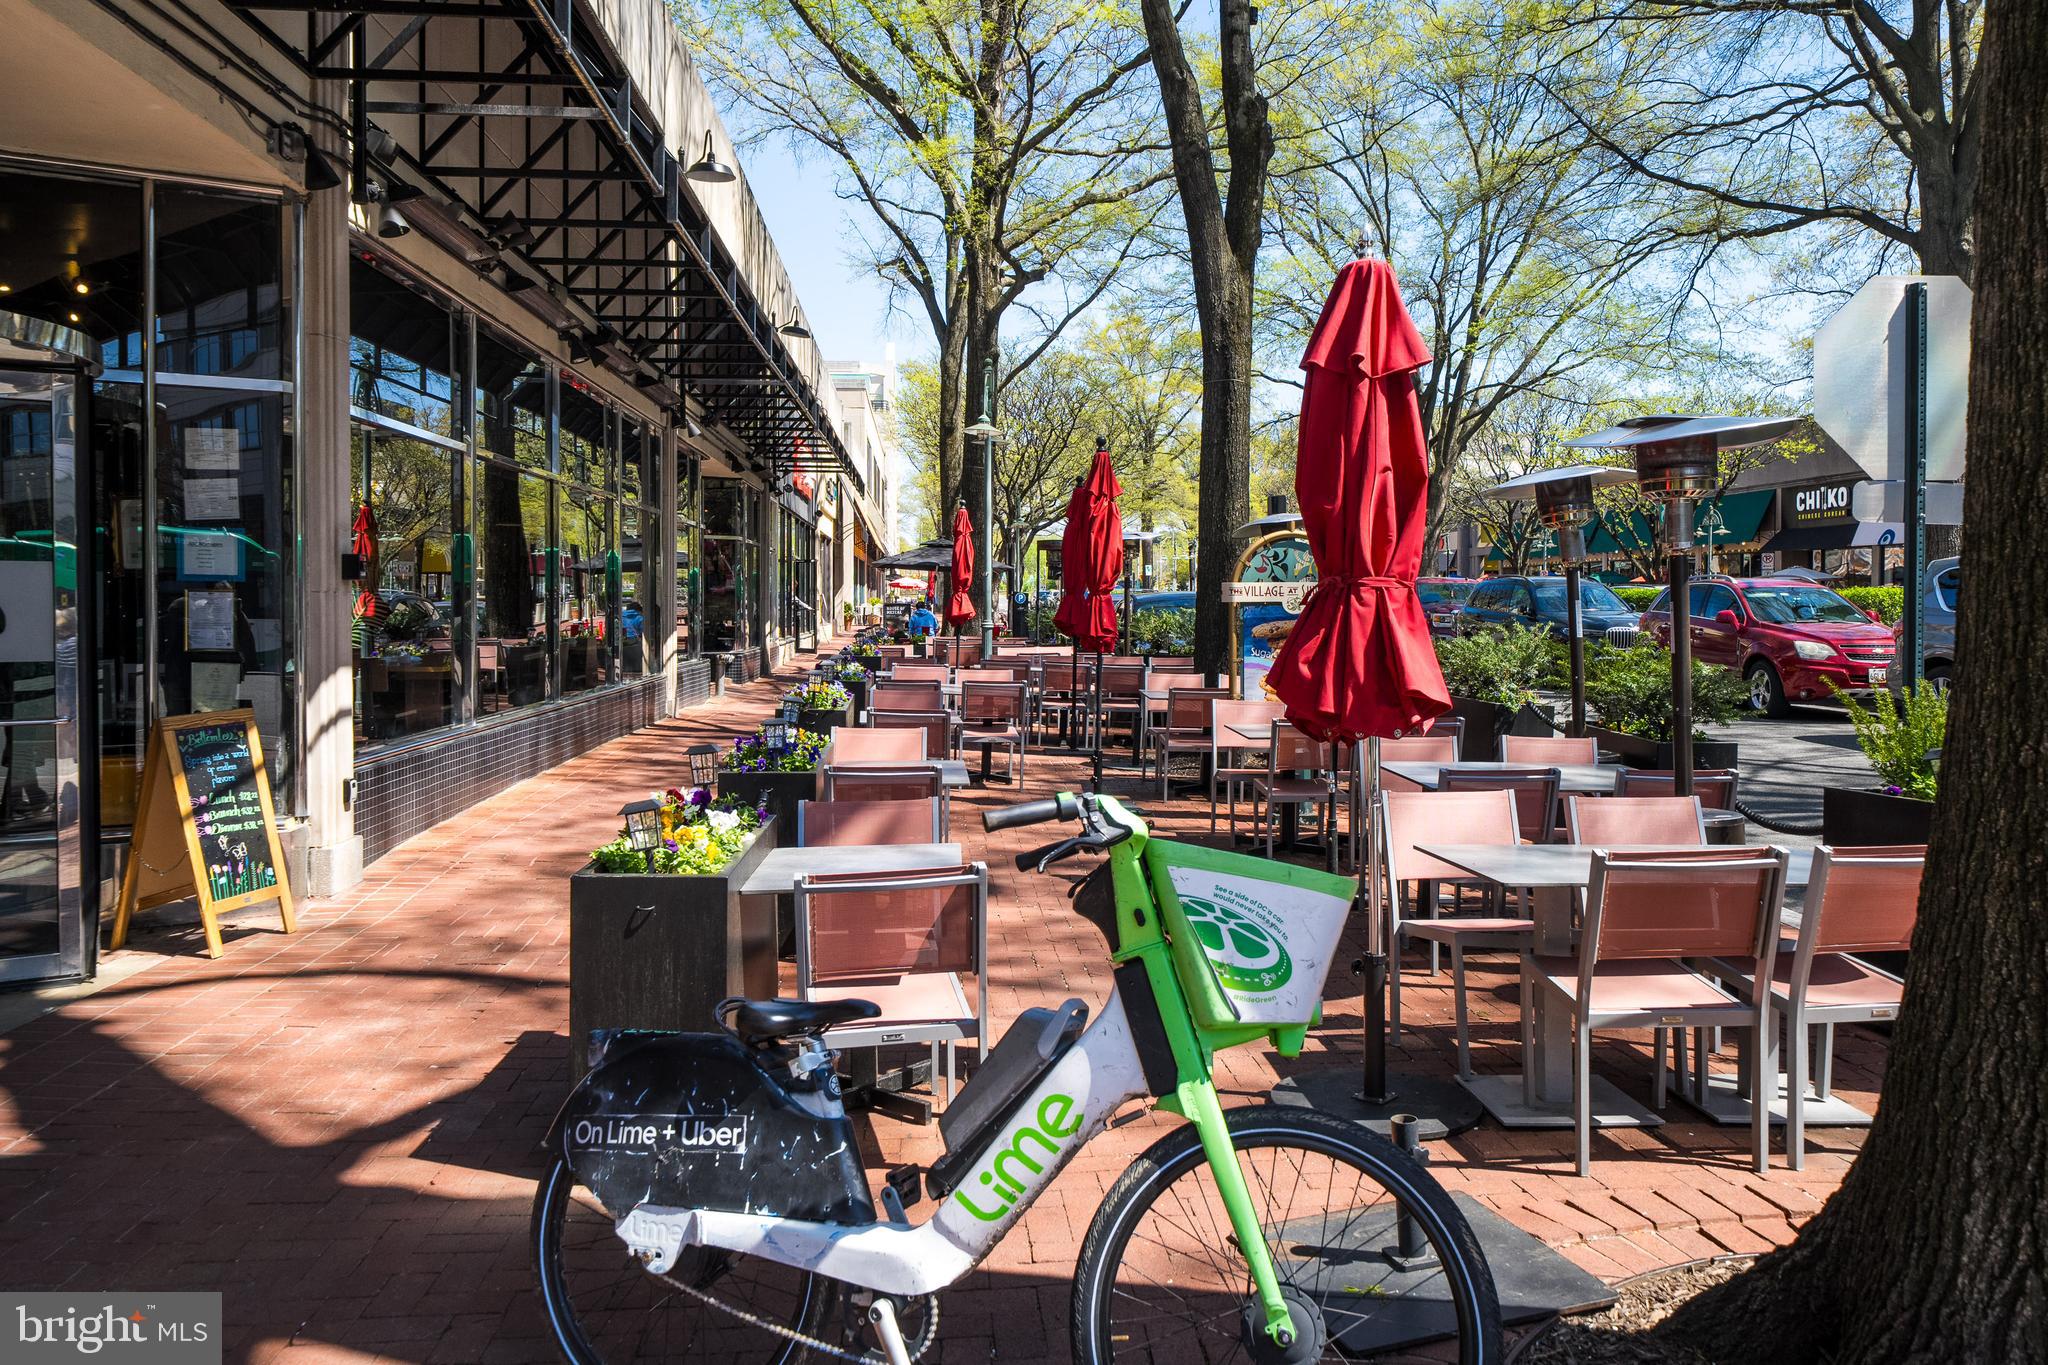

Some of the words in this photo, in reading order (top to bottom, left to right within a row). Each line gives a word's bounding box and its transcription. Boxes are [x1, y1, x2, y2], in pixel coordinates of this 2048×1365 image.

[1243, 586, 1285, 597] VILLAGE
[231, 748, 250, 759] world
[208, 789, 236, 805] Lunch
[208, 804, 242, 821] Brunch
[1213, 892, 1236, 905] would
[1235, 901, 1256, 914] never
[1255, 911, 1271, 924] take
[1269, 921, 1283, 934] you
[1214, 884, 1228, 894] See
[1234, 892, 1250, 902] side
[1257, 902, 1268, 912] DC
[1272, 913, 1285, 925] car
[574, 1120, 603, 1145] On
[606, 1120, 657, 1145] Lime
[662, 1125, 676, 1141] +
[680, 1122, 742, 1147] Uber
[954, 1093, 1085, 1222] Lime
[631, 1215, 683, 1242] Lime
